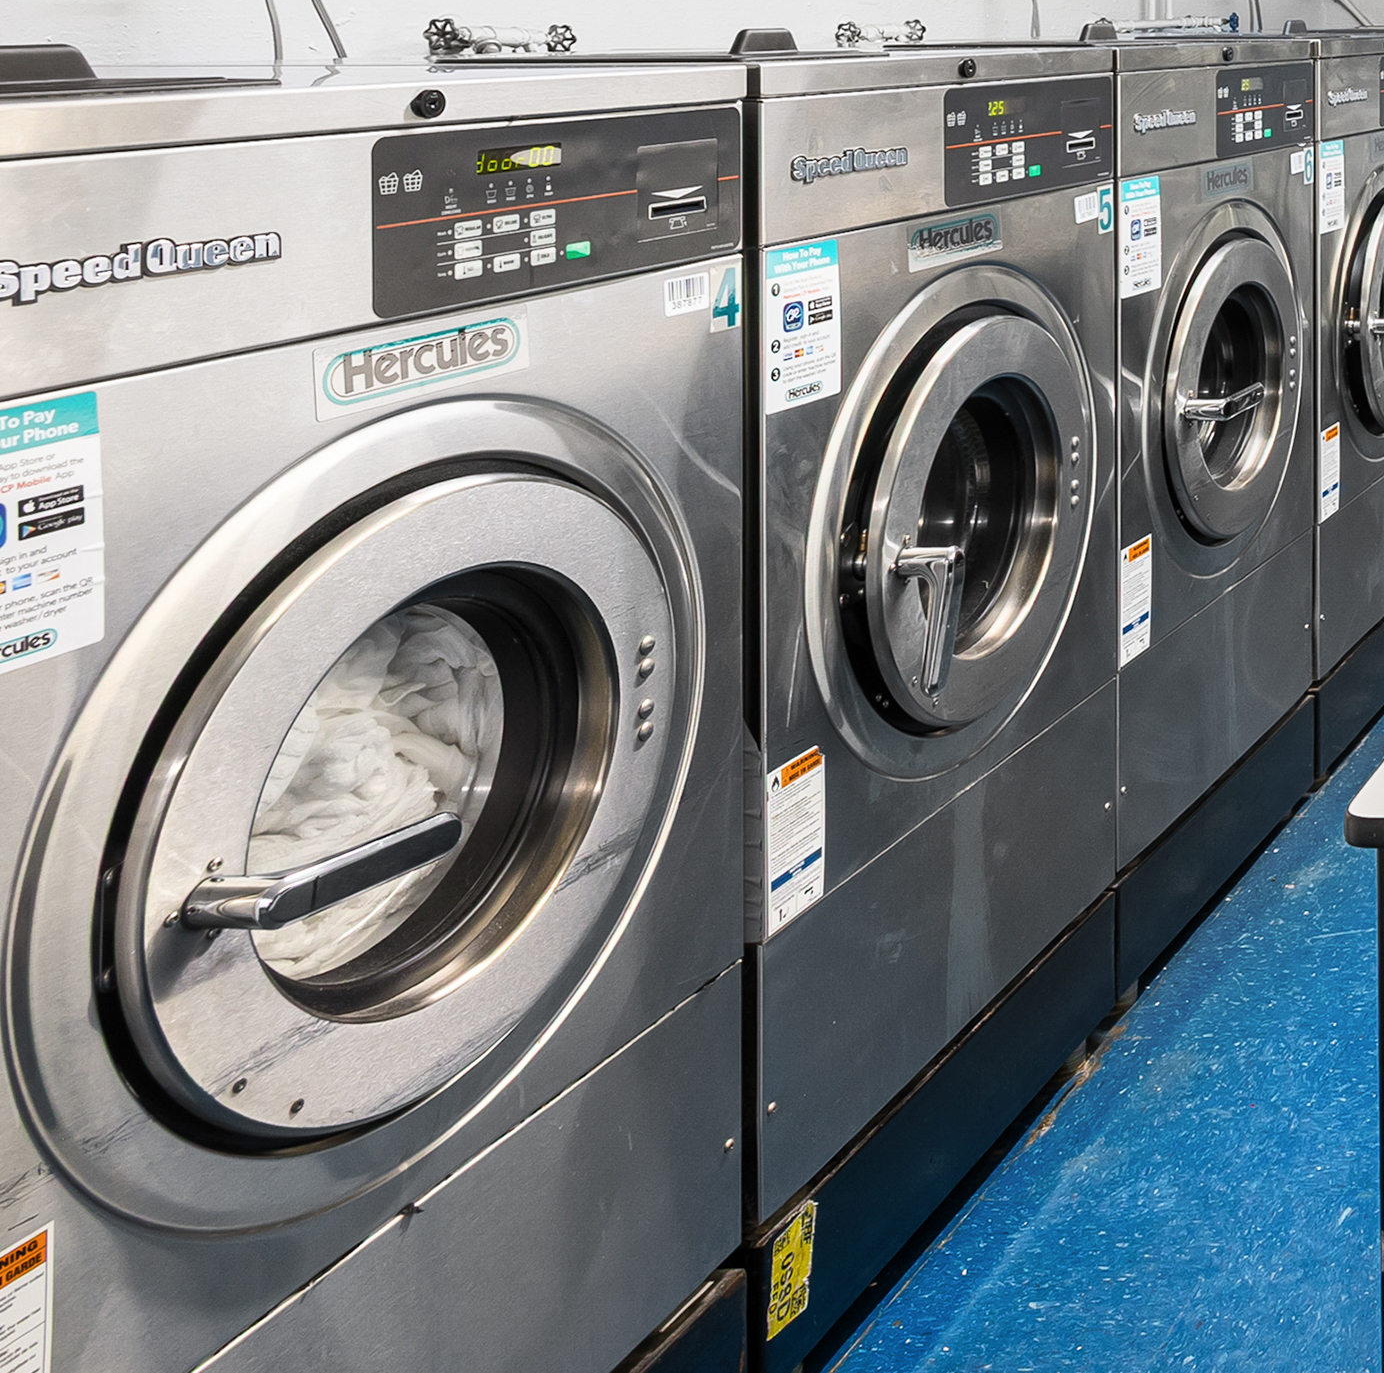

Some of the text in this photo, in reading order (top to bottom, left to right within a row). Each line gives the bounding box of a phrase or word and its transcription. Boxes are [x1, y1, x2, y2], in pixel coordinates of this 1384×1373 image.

[791, 146, 909, 184] Speed Queen
[1304, 148, 1313, 182] 6
[1206, 168, 1248, 191] Hercules
[1100, 188, 1112, 231] 5
[918, 218, 993, 251] Hercules
[146, 232, 281, 276] Queen
[774, 256, 831, 274] With Your Phone
[782, 246, 822, 261] How To Pay
[712, 267, 740, 328] 4
[343, 328, 509, 394] Hercules
[788, 382, 821, 400] Hercules
[0, 409, 56, 431] To Pay
[0, 422, 79, 449] ur Phone
[38, 494, 79, 511] App Store
[37, 517, 66, 531] Google
[40, 548, 77, 565] account
[17, 588, 93, 617] machine number
[0, 632, 51, 657] cules
[6, 1252, 43, 1282] GARDE
